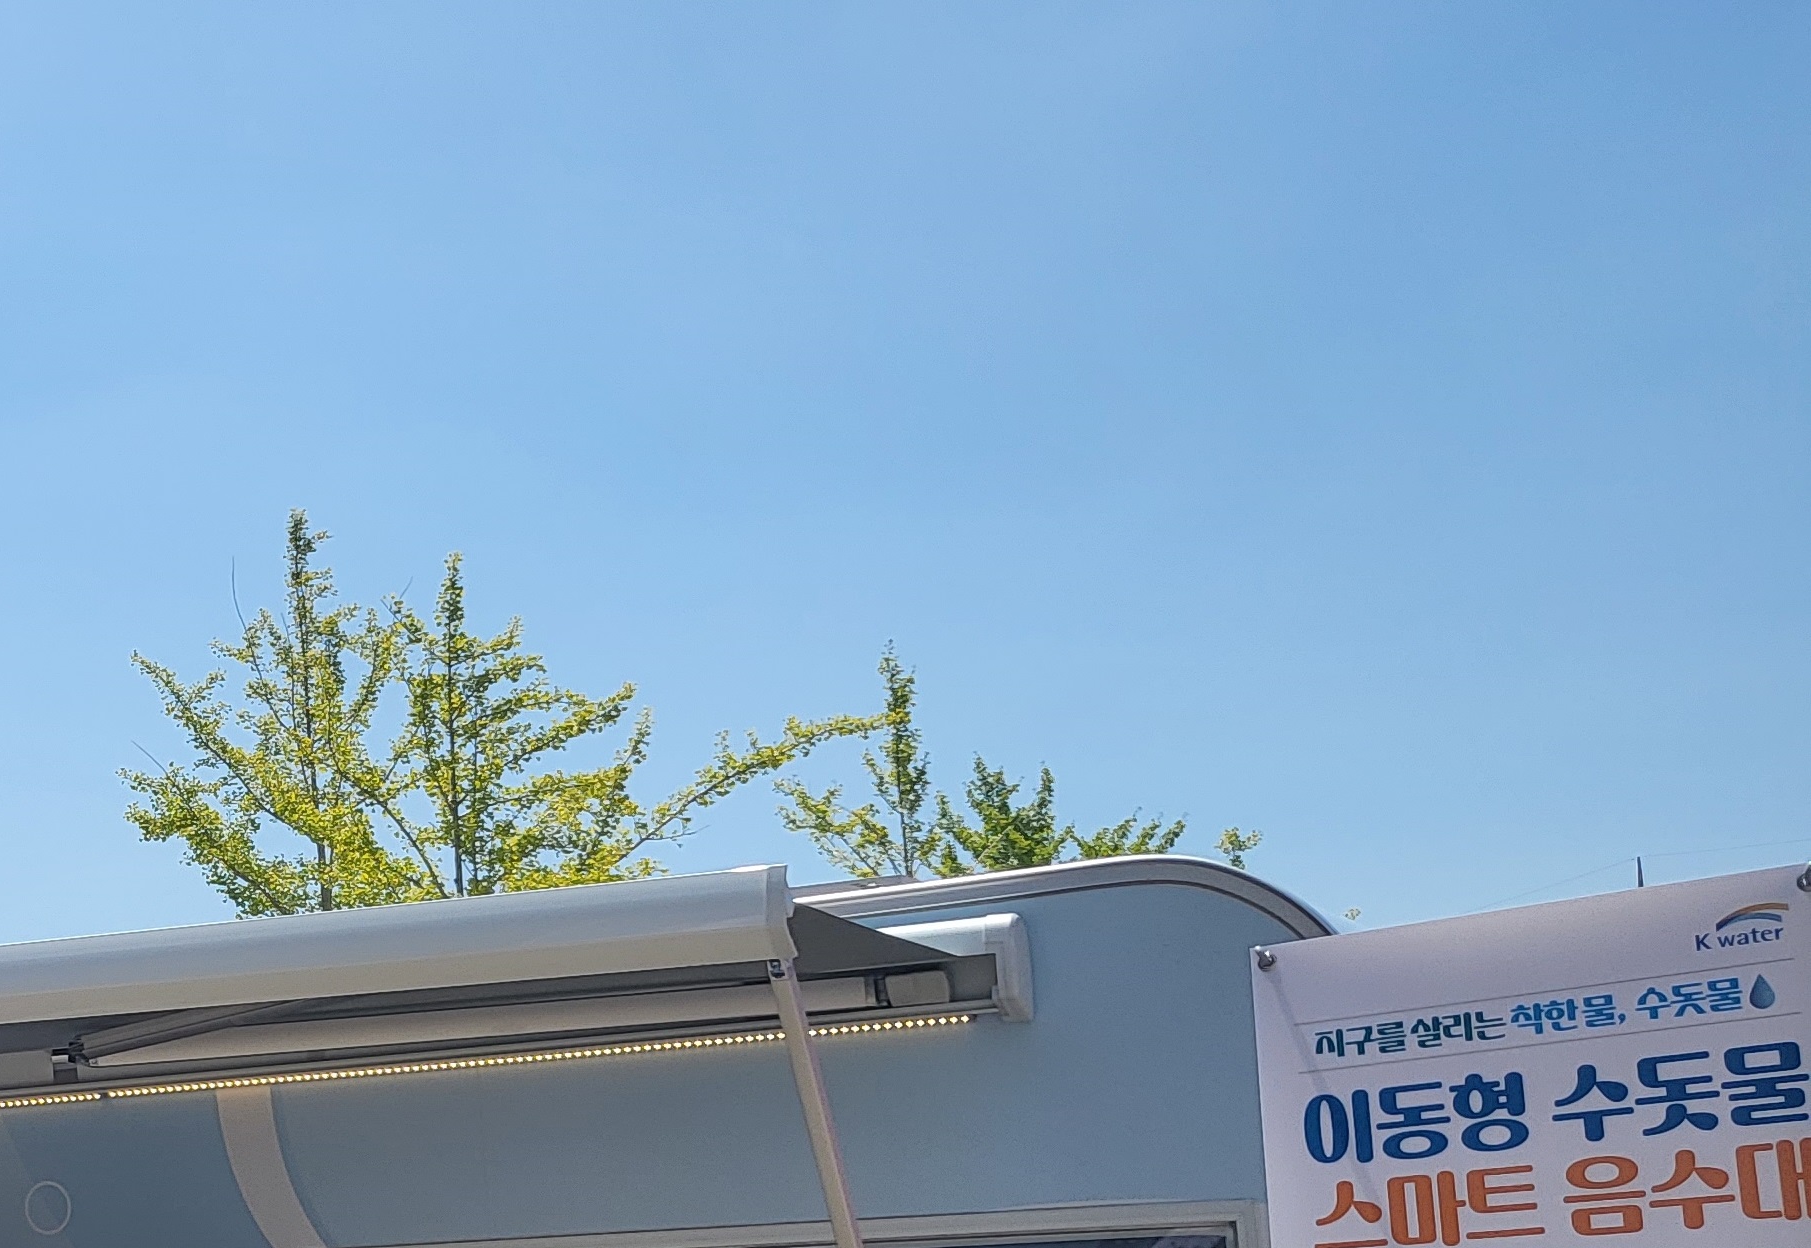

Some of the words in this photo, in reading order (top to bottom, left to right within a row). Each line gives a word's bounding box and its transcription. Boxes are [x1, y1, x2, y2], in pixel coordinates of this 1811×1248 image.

[1695, 934, 1712, 951] K
[1716, 926, 1784, 949] water
[1315, 1021, 1407, 1057] 지구를
[1410, 1011, 1506, 1049] 살리는
[1510, 1000, 1578, 1035] 착한
[1582, 993, 1626, 1027] 물,
[1635, 976, 1744, 1020] 수돗물
[1304, 1072, 1529, 1164] 이동형
[1552, 1041, 1811, 1142] 수돗물
[1564, 1138, 1811, 1236] 음수대
